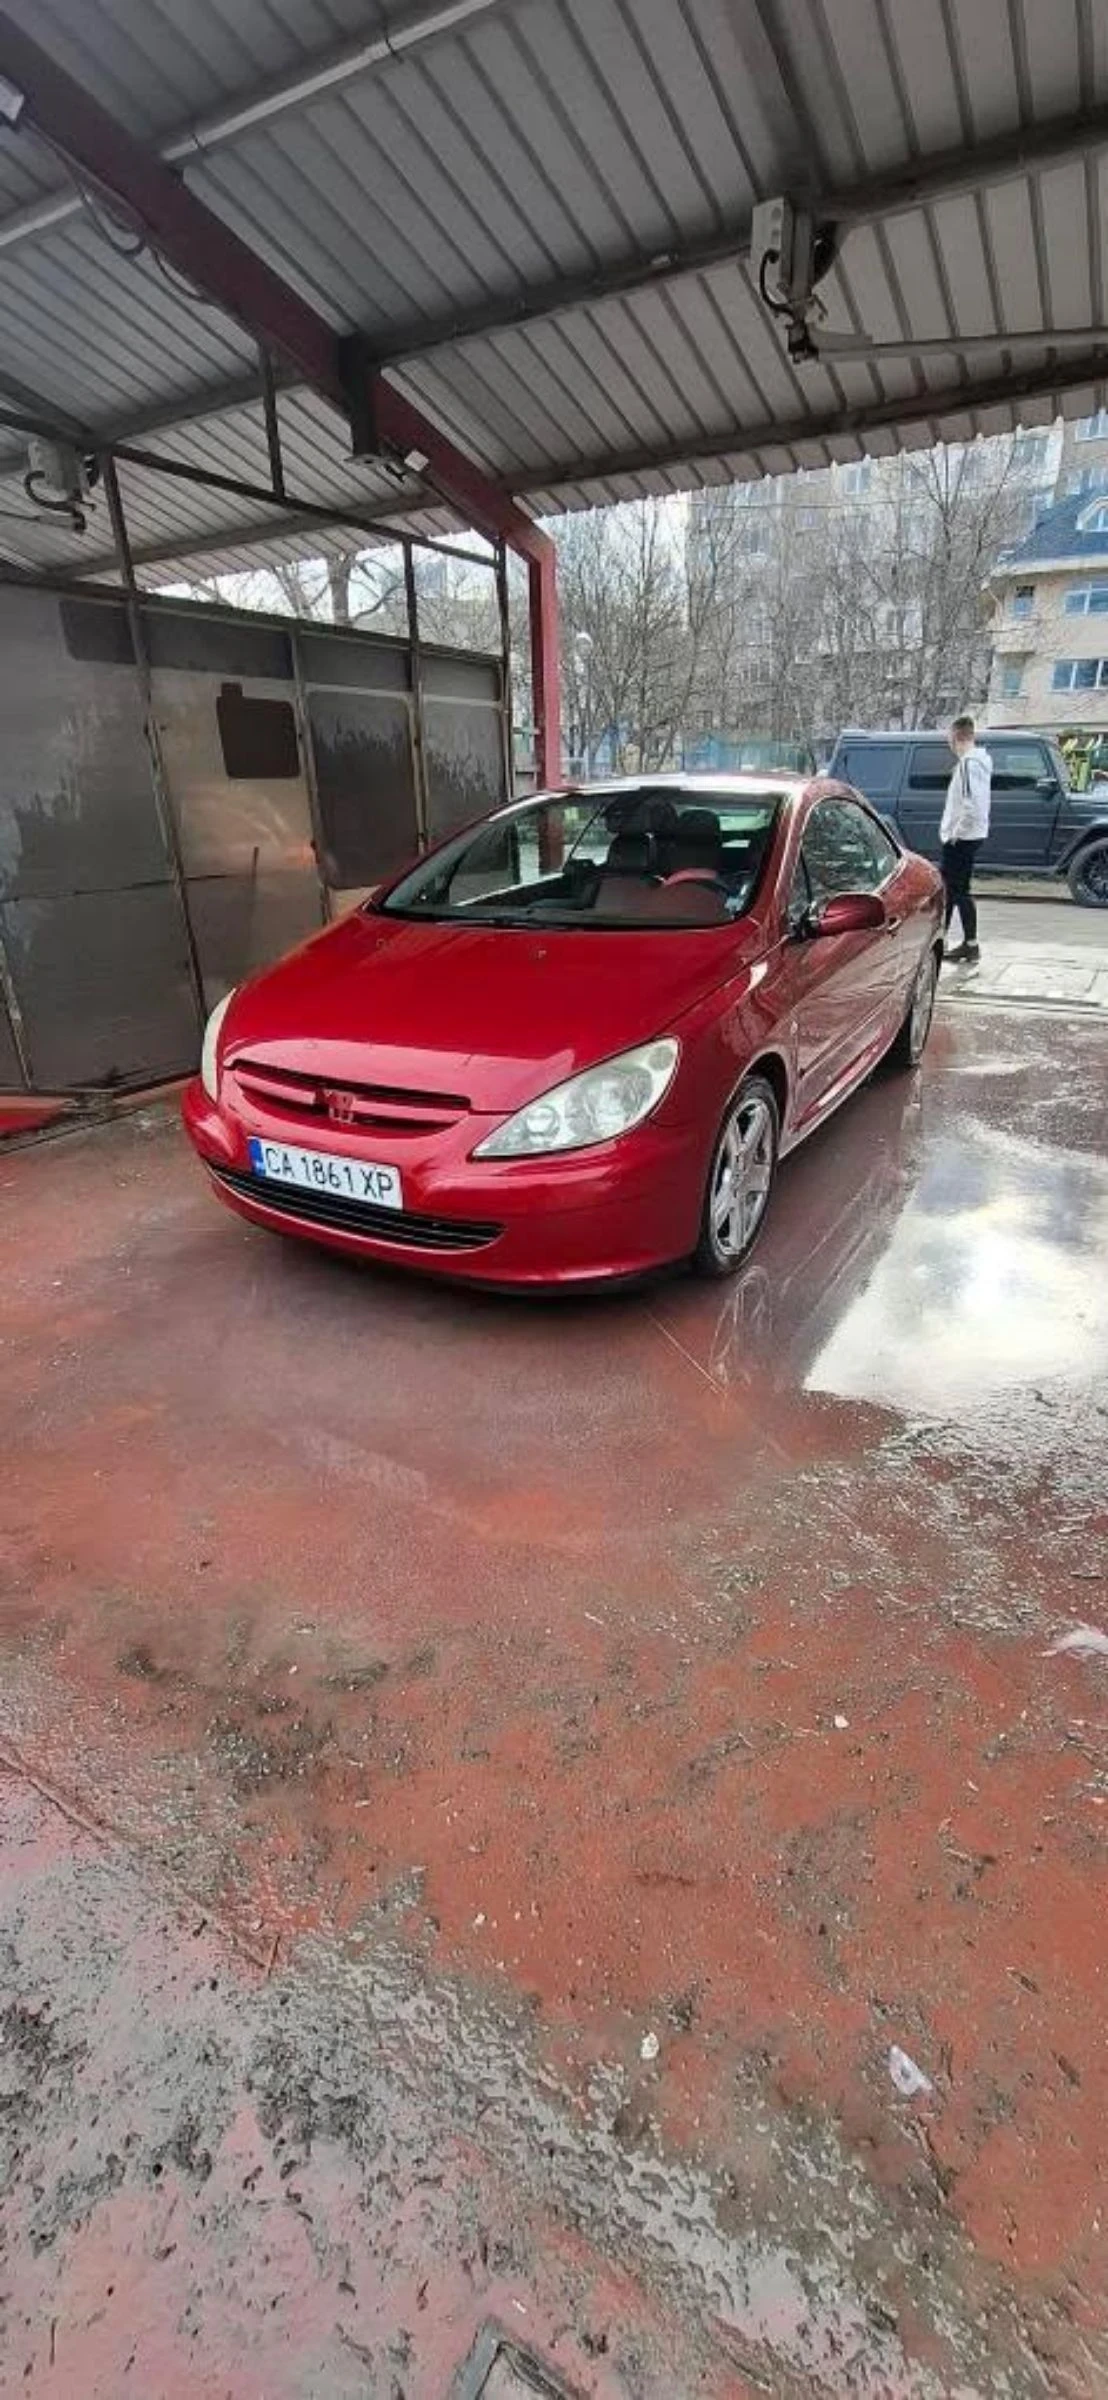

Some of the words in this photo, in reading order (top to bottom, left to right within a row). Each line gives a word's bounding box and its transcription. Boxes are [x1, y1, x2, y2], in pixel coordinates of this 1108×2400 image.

[265, 1148, 295, 1179] CA
[301, 1156, 354, 1192] 1861
[361, 1168, 393, 1199] XP
